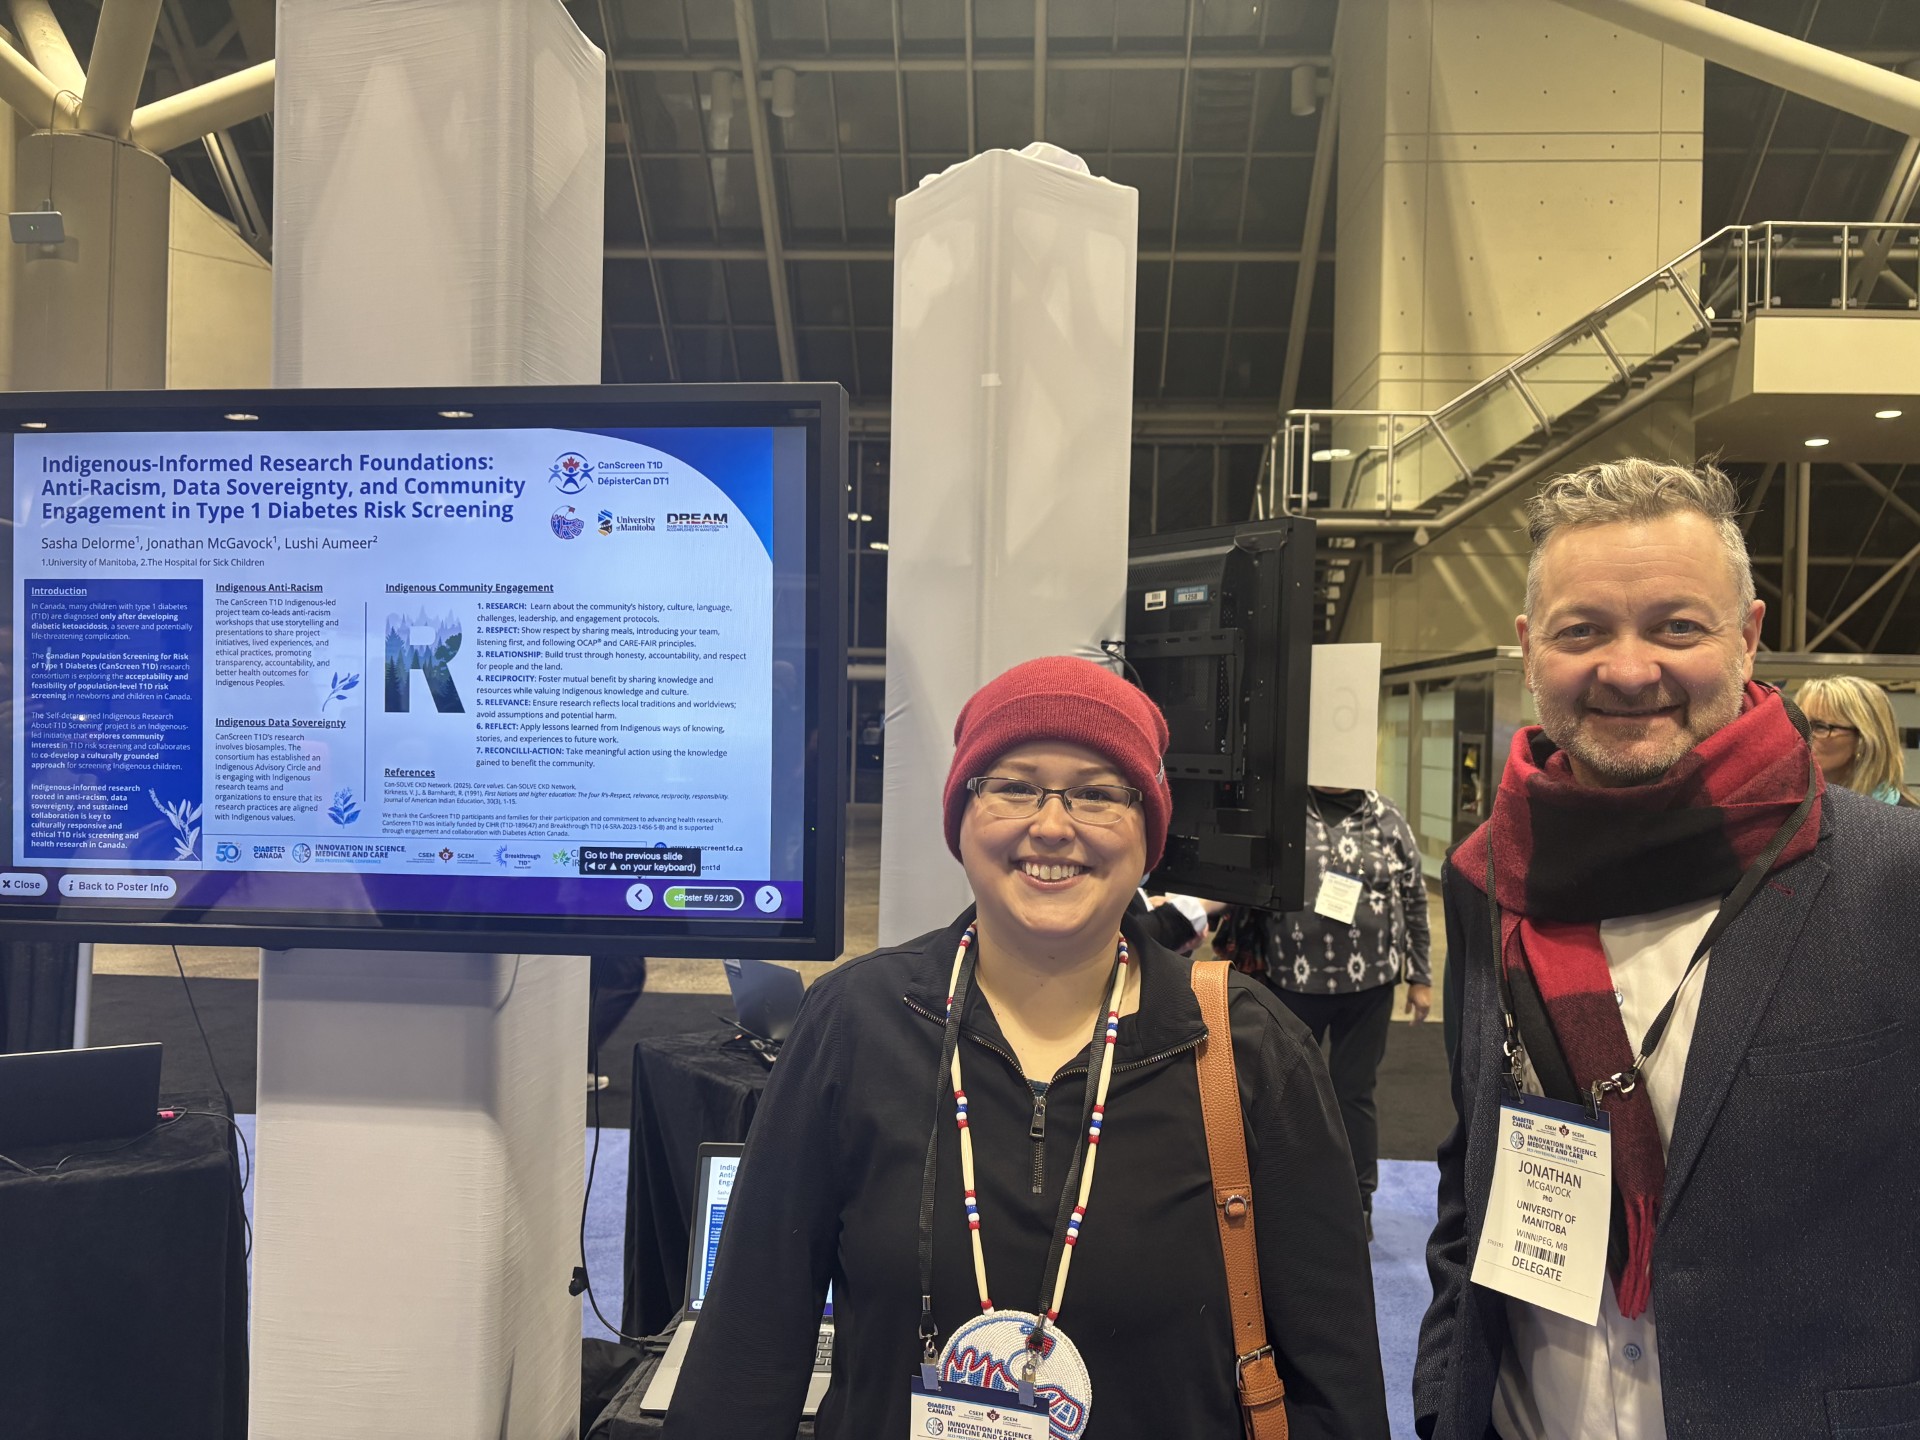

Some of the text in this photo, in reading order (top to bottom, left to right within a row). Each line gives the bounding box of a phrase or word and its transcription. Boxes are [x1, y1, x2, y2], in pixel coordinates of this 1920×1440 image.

[43, 454, 493, 476] Indigenous-Informed Research Foundations:
[598, 477, 669, 486] DépisterCan DT1
[42, 478, 525, 499] Anti-Racism, Data Sovereignty, and Community
[43, 502, 514, 523] Engagement in Type 1 Diabetes Risk Screening
[616, 516, 655, 524] University
[667, 513, 728, 524] DREAM
[42, 537, 76, 549] Sasha
[145, 536, 203, 549] Jonathan
[285, 536, 317, 549] Lushi
[88, 558, 96, 566] of
[99, 558, 138, 568] Manitoba,
[164, 558, 197, 569] Hospital
[199, 558, 210, 567] for
[213, 558, 228, 567] Sick
[230, 558, 264, 567] Children
[31, 587, 87, 595] Introduction
[216, 583, 323, 593] Indigenous Anti-Racism
[386, 583, 554, 594] Indigenous Community Engagement
[215, 598, 336, 608] The CanScreen T1D Indigenous-led
[485, 602, 526, 610] RESEARCH:
[530, 602, 551, 610] Learn
[552, 602, 574, 610] about
[575, 602, 588, 610] the
[589, 602, 636, 612] community's
[637, 602, 665, 613] history,
[666, 603, 694, 612] culture,
[696, 603, 732, 613] language,
[31, 612, 49, 622] (T1D)
[63, 612, 98, 622] diagnosed
[100, 612, 116, 622] only
[117, 612, 136, 620] after
[137, 612, 178, 622] developing
[485, 626, 519, 634] RESPECT:
[521, 626, 541, 634] Show
[542, 627, 569, 636] respect
[571, 626, 580, 636] by
[582, 626, 609, 636] sharing
[610, 626, 634, 636] meals,
[636, 627, 678, 637] introducing
[680, 629, 697, 637] your
[698, 628, 719, 636] team,
[215, 718, 346, 729] Indigenous Data Sovereignty
[215, 733, 304, 741] CanScreen T1D's research
[476, 747, 483, 755] 7.
[565, 747, 583, 755] Take
[584, 748, 626, 758] meaningful
[652, 749, 672, 758] using
[673, 748, 686, 756] the
[687, 748, 727, 759] knowledge
[384, 768, 435, 777] References
[31, 783, 140, 793] Indigenous-informed research
[584, 851, 682, 862] Go to the previous slide
[633, 864, 652, 873] your
[654, 863, 696, 874] keyboard)
[14, 881, 40, 889] Close
[79, 882, 168, 892] Back to Poster Info
[1512, 1116, 1534, 1125] DIABETES
[1512, 1121, 1532, 1130] CANADA
[1527, 1141, 1554, 1152] MEDICINE
[1555, 1148, 1568, 1156] AND
[1569, 1152, 1583, 1160] CARE
[1528, 1135, 1564, 1148] INNOVATION
[1573, 1146, 1597, 1158] SCIENCE,
[1518, 1160, 1581, 1189] JONATHAN
[1527, 1179, 1571, 1198] MCGAVOCK
[1517, 1200, 1576, 1224] UNIVERSITY OF
[1522, 1214, 1566, 1236] MANITOBA
[1516, 1228, 1554, 1248] WINNIPEG,
[1556, 1241, 1568, 1251] MB
[1512, 1256, 1562, 1282] DELEGATE
[927, 1402, 955, 1411] DIABETES
[928, 1408, 953, 1416] CANADA
[948, 1421, 992, 1433] INNOVATION
[1004, 1431, 1032, 1439] SCIENCE,
[948, 1427, 980, 1437] MEDICINE
[982, 1432, 997, 1440] AND
